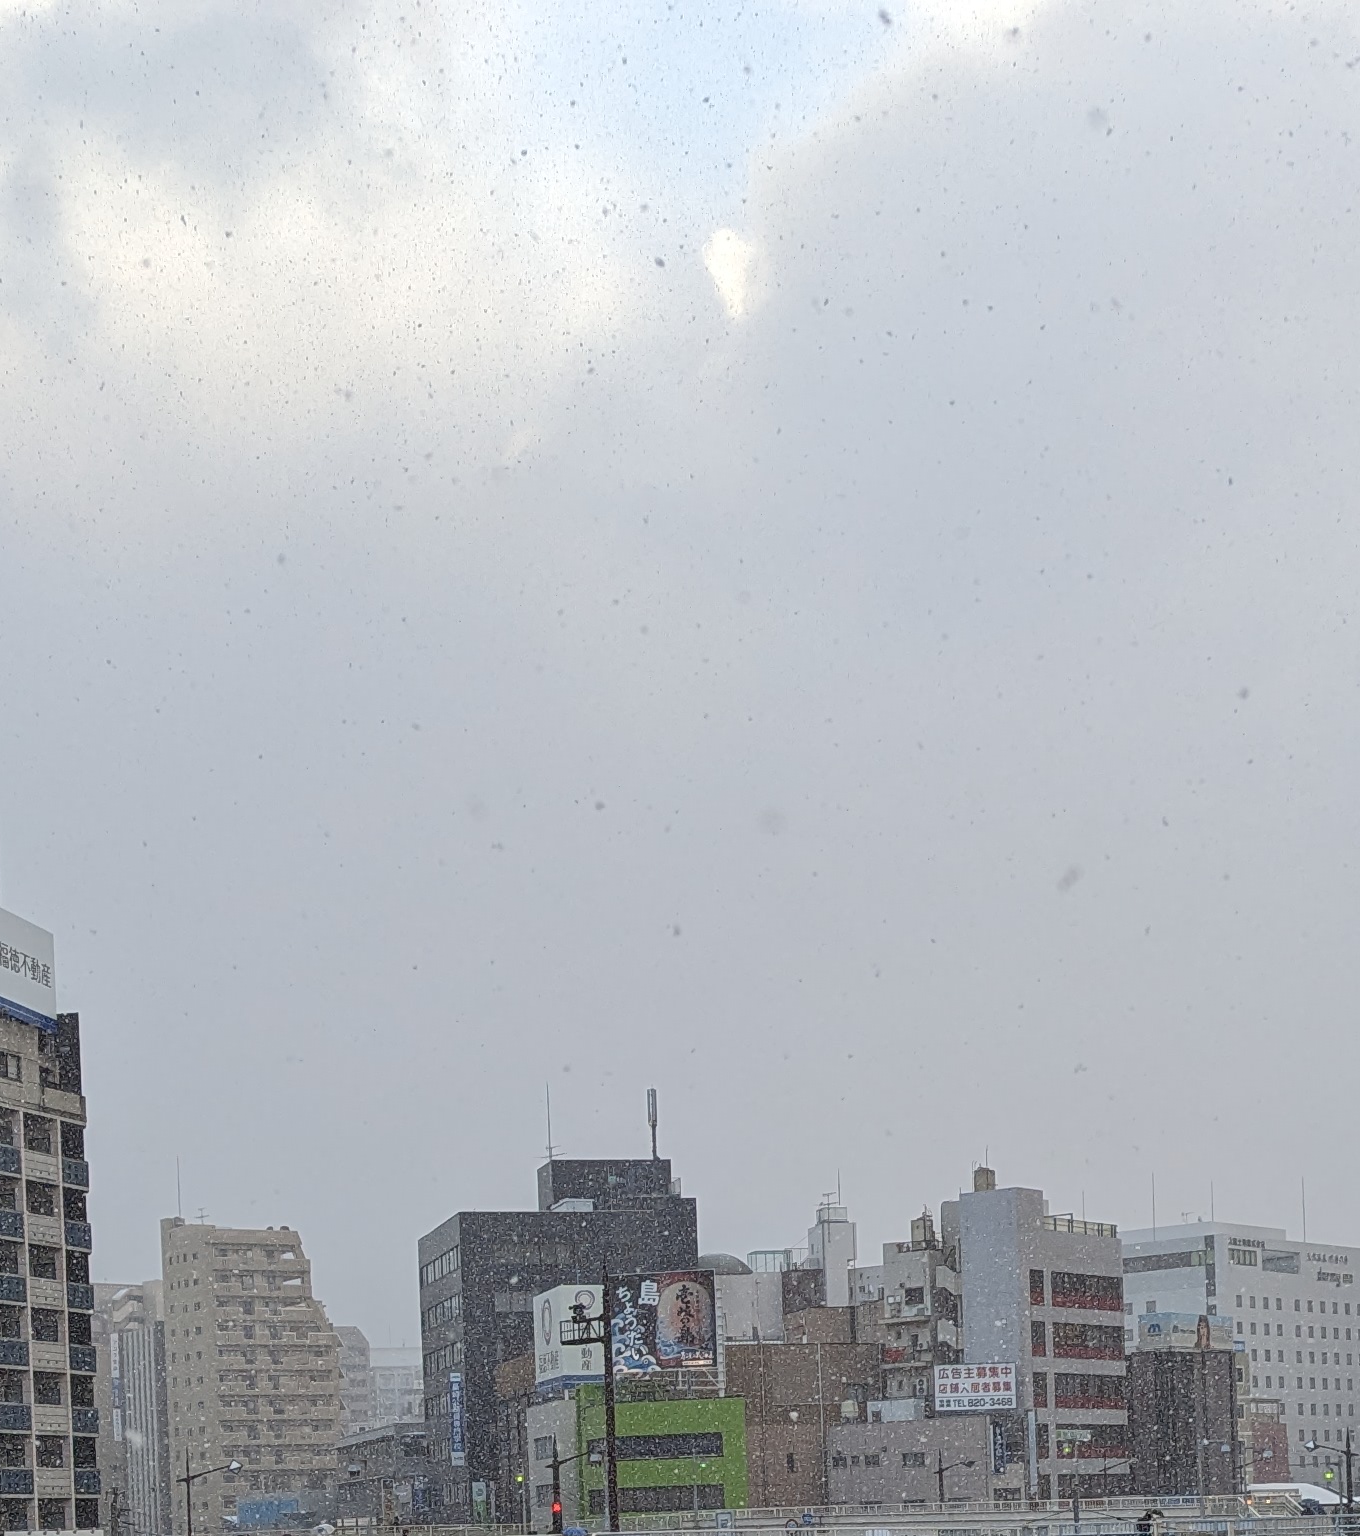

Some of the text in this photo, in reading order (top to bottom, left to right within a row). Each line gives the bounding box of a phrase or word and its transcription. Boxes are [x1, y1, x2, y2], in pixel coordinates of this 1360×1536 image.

[638, 1280, 660, 1306] 島
[938, 1366, 1012, 1380] 広告主募集中
[953, 1398, 967, 1408] TEL
